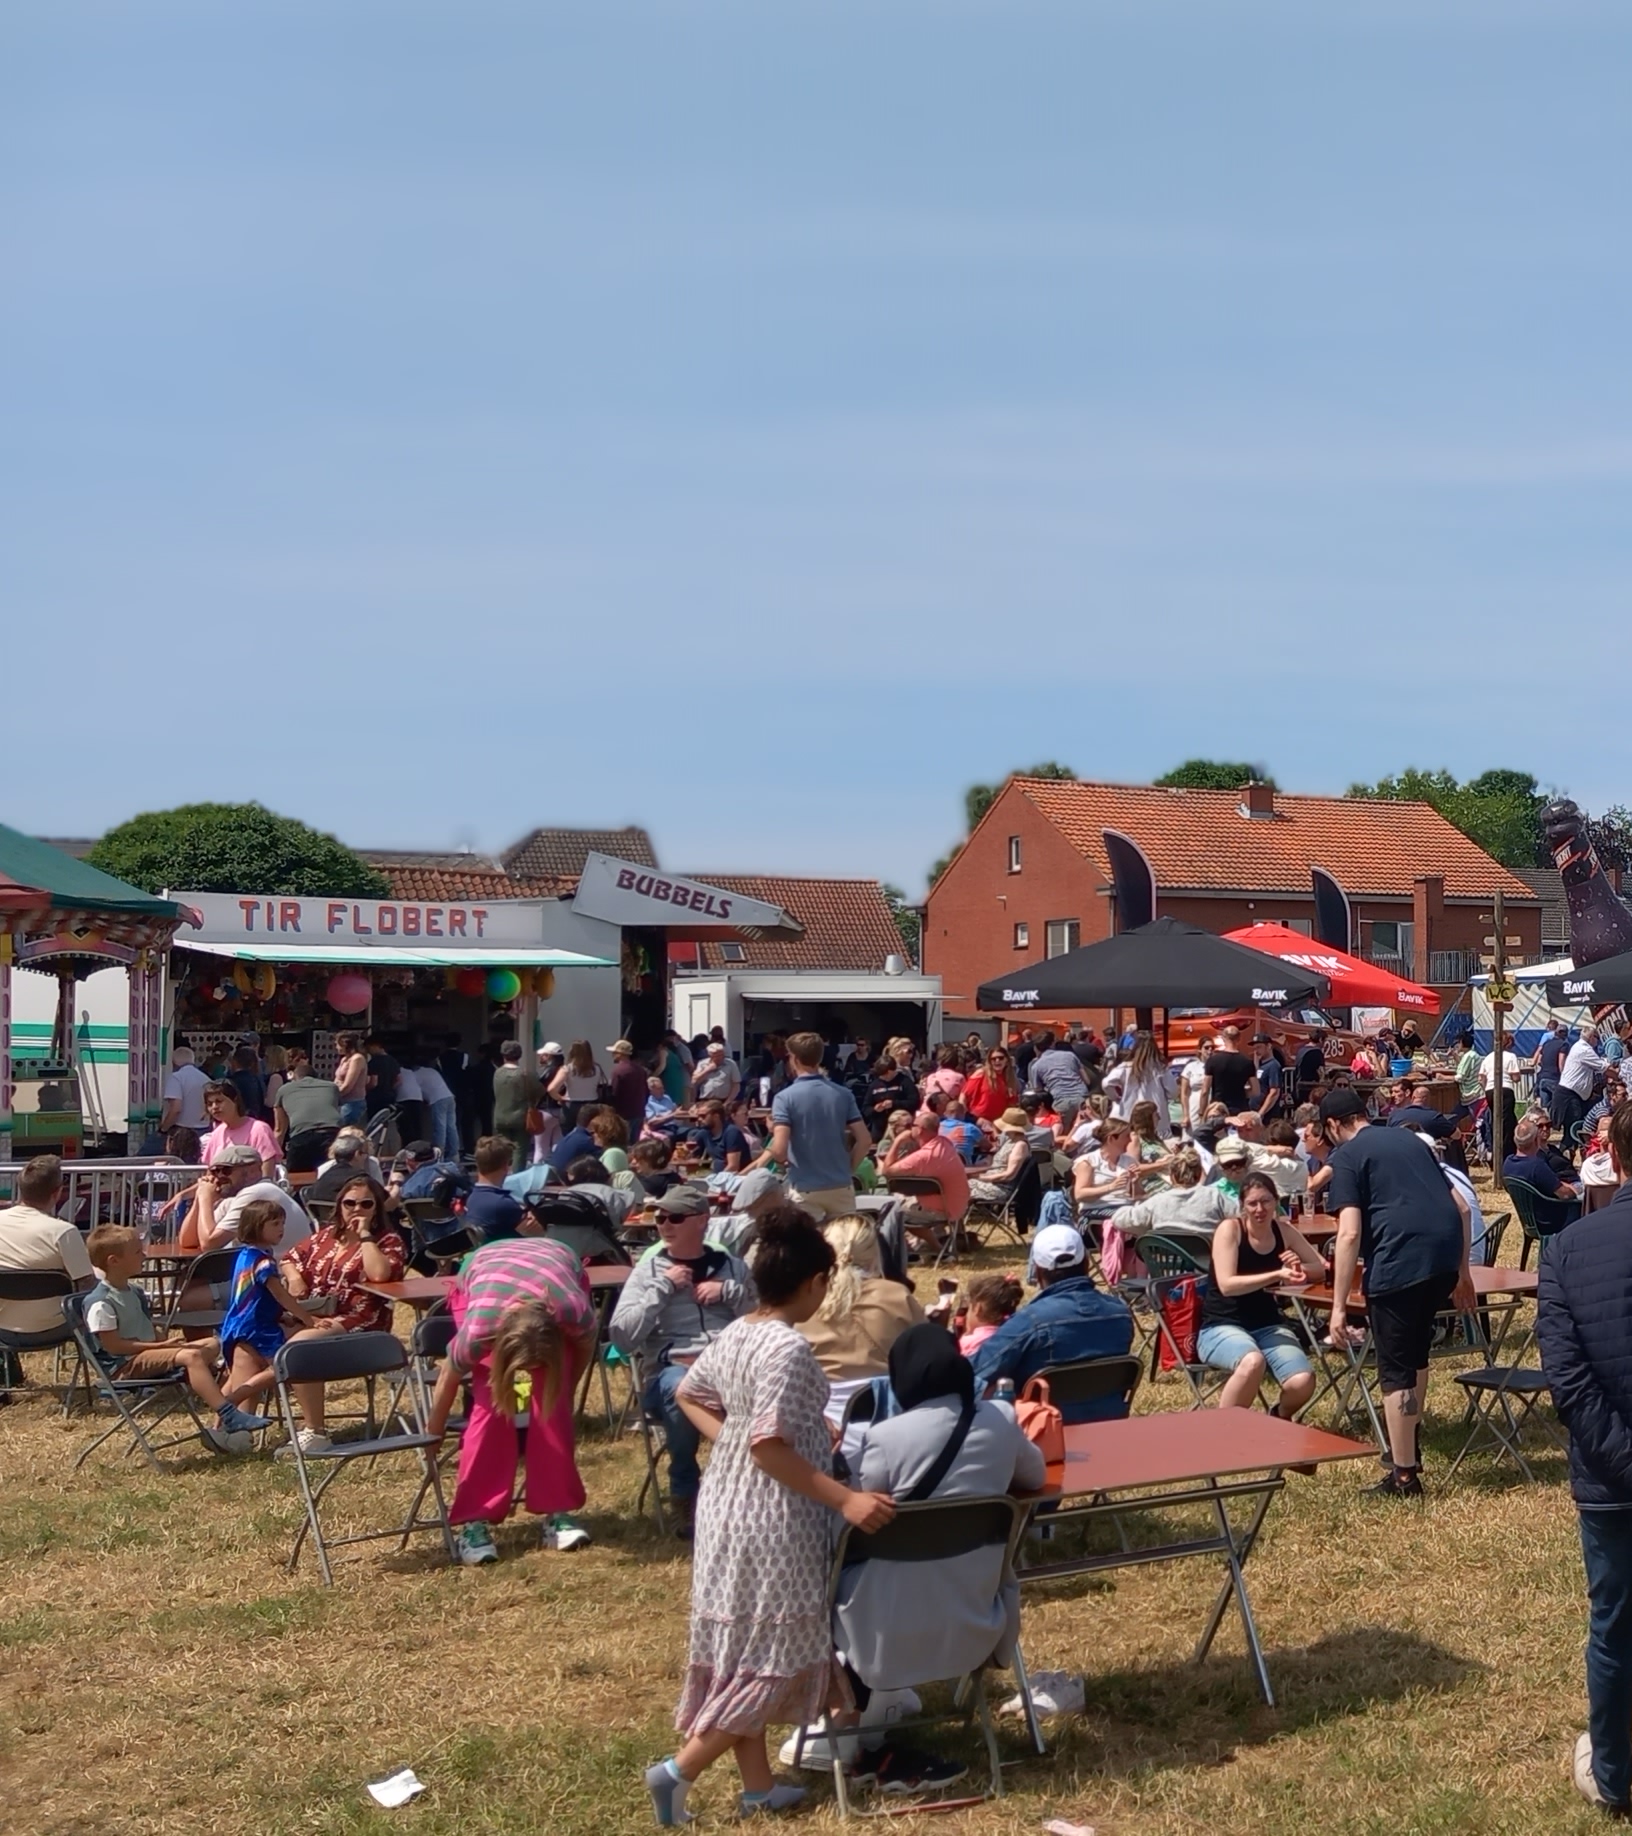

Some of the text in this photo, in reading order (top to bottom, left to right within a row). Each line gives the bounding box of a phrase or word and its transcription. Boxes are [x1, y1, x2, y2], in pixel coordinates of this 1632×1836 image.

[616, 868, 733, 919] BUBBELS
[238, 900, 489, 938] TIR FLOBERT
[1278, 953, 1354, 971] AVIK
[1488, 987, 1511, 1000] WC
[1563, 979, 1596, 994] BAVIK
[1003, 989, 1040, 1001] BAVIK
[1251, 988, 1288, 1001] BAVIK
[1397, 991, 1425, 1005] BAVIK
[1323, 1039, 1345, 1059] 285
